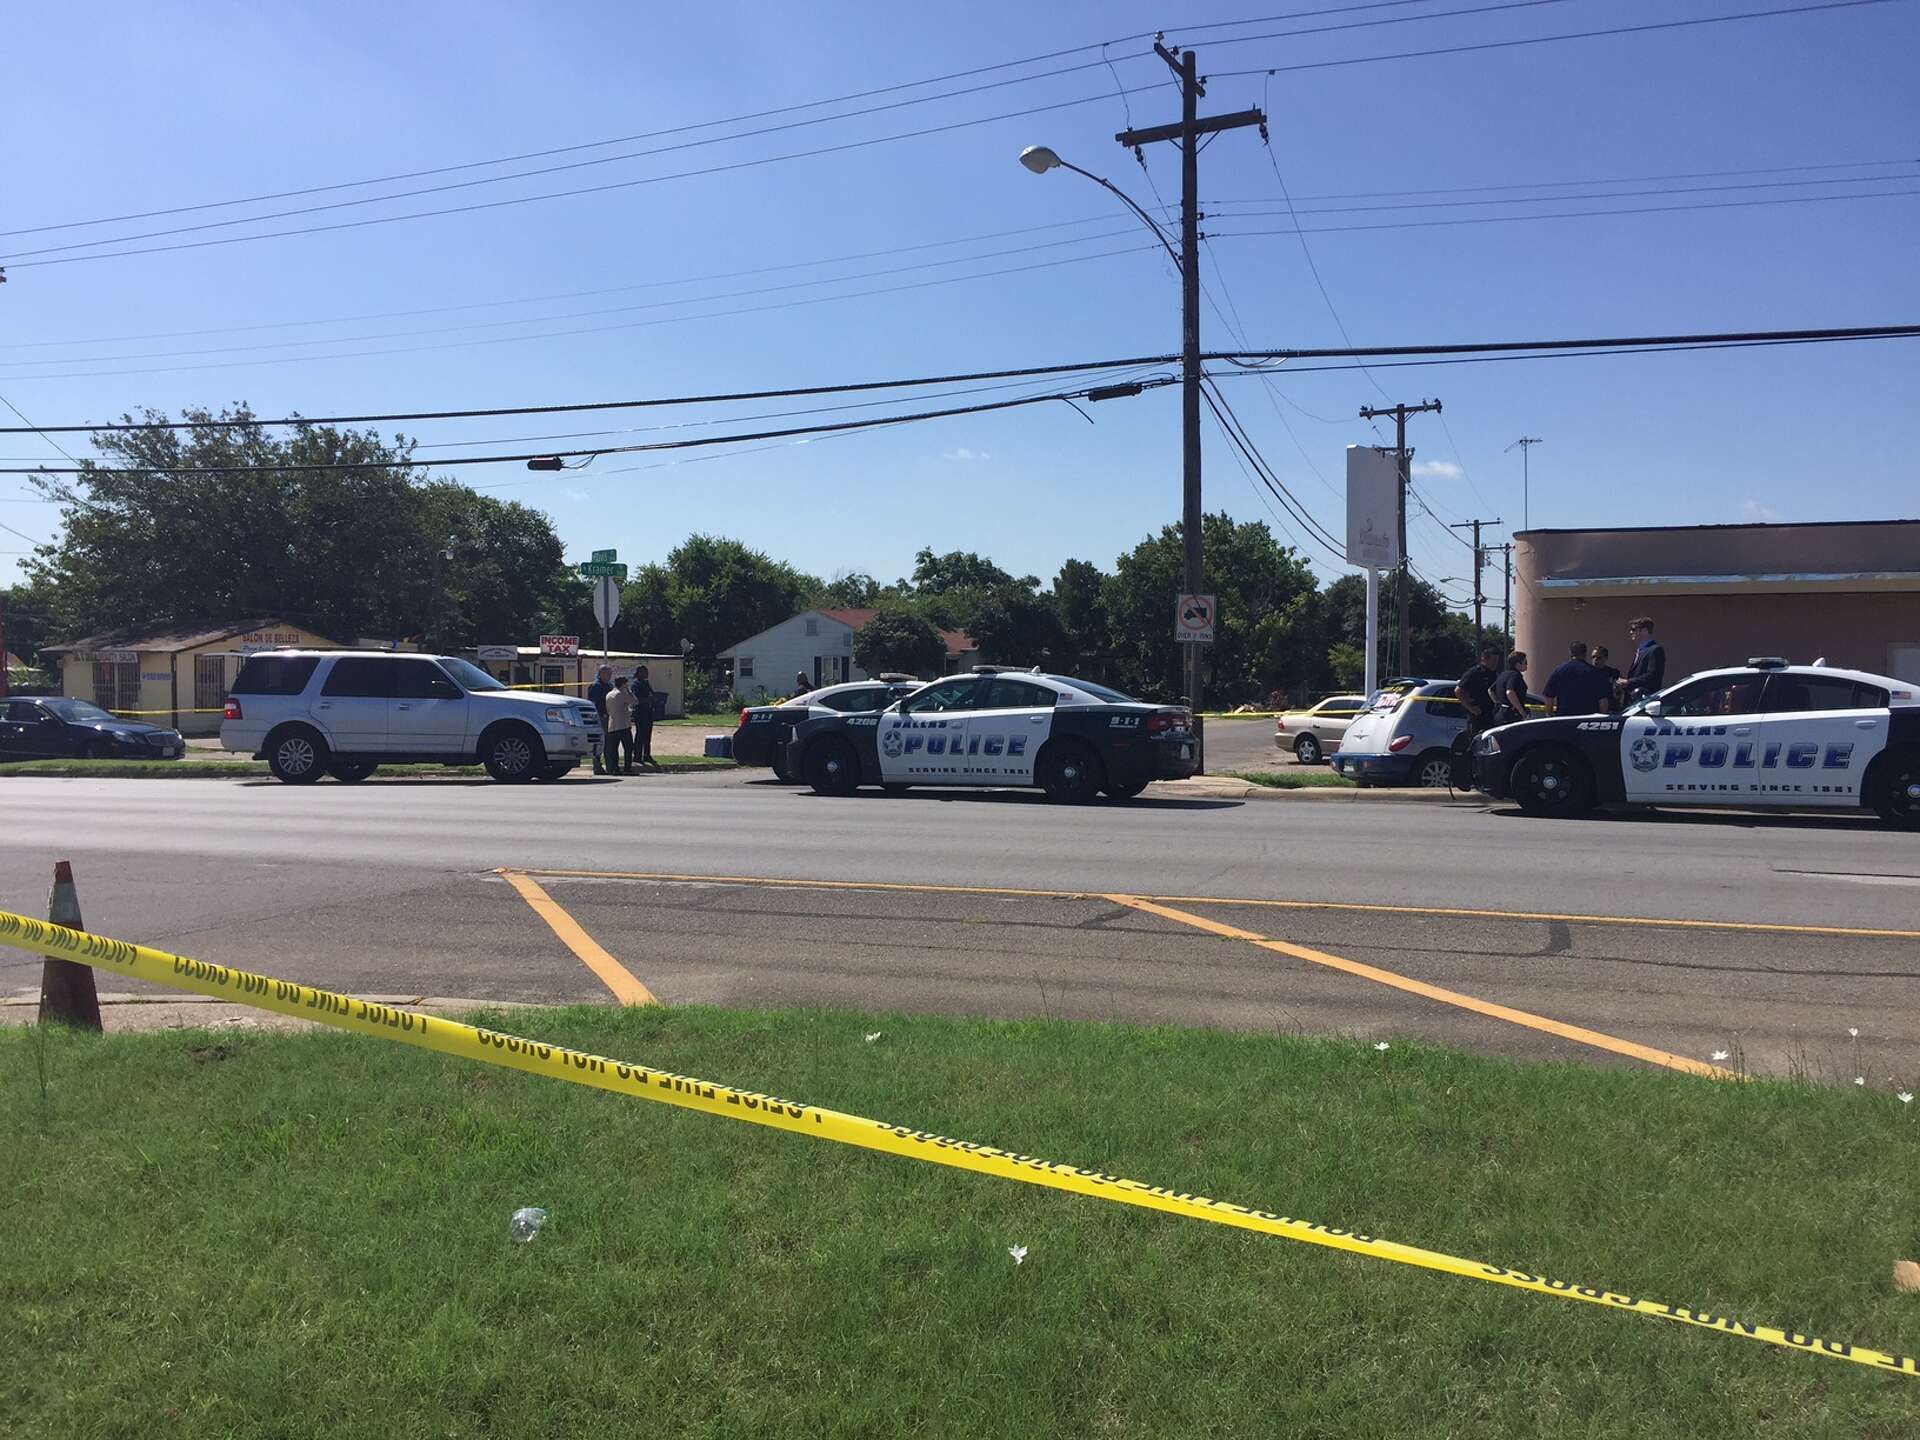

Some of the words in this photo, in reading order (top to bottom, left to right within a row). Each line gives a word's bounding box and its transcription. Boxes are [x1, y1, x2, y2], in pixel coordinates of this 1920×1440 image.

[541, 636, 577, 645] INCOME
[547, 645, 570, 653] TAX
[893, 720, 948, 729] DALLAS
[1576, 721, 1620, 731] 4251
[1643, 725, 1728, 736] DALLAS
[903, 733, 1028, 757] POLICE
[1662, 742, 1855, 769] POLICE
[963, 767, 998, 775] SINCE
[1665, 784, 1741, 792] SERVING
[1750, 784, 1803, 793] SINCE
